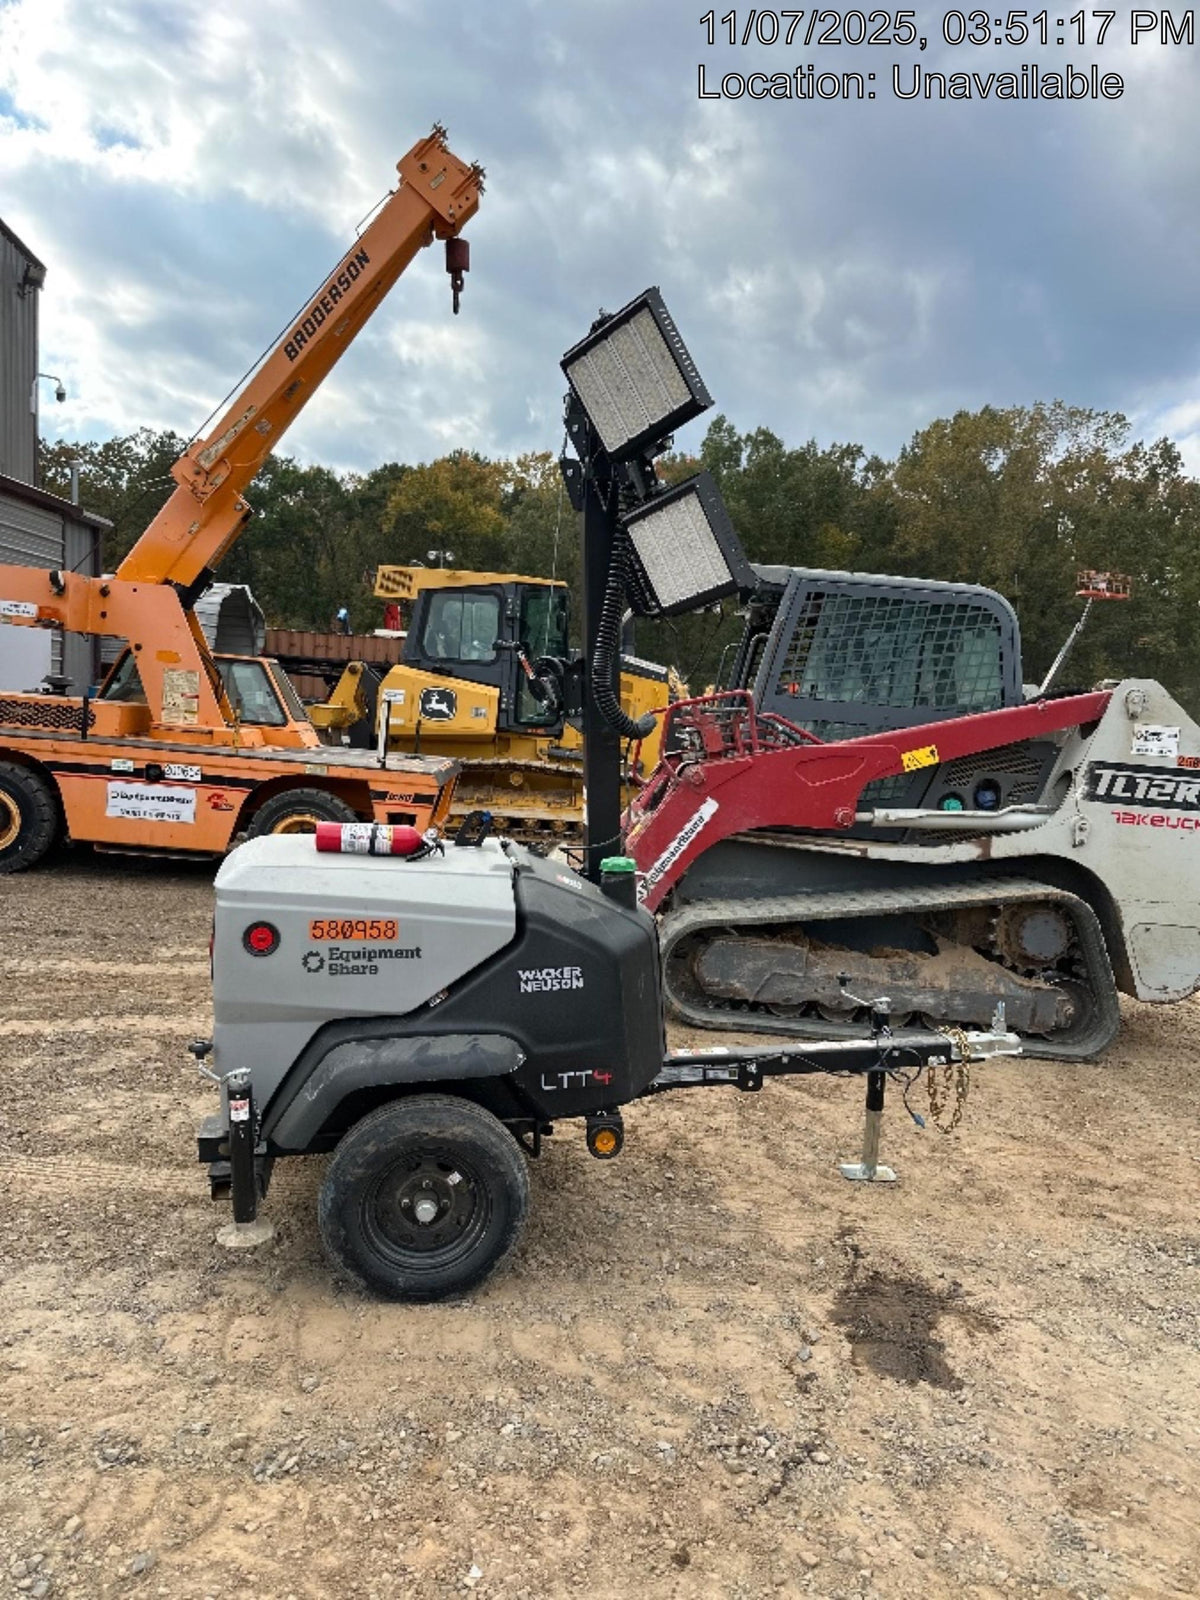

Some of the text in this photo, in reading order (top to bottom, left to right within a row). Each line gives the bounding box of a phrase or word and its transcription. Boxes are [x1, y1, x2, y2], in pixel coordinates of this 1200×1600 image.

[284, 247, 370, 362] BRODERSON
[312, 920, 396, 939] 580958
[328, 947, 422, 962] Equipment
[328, 963, 379, 976] Share
[518, 966, 583, 981] WACKER
[520, 978, 584, 993] NEUSON
